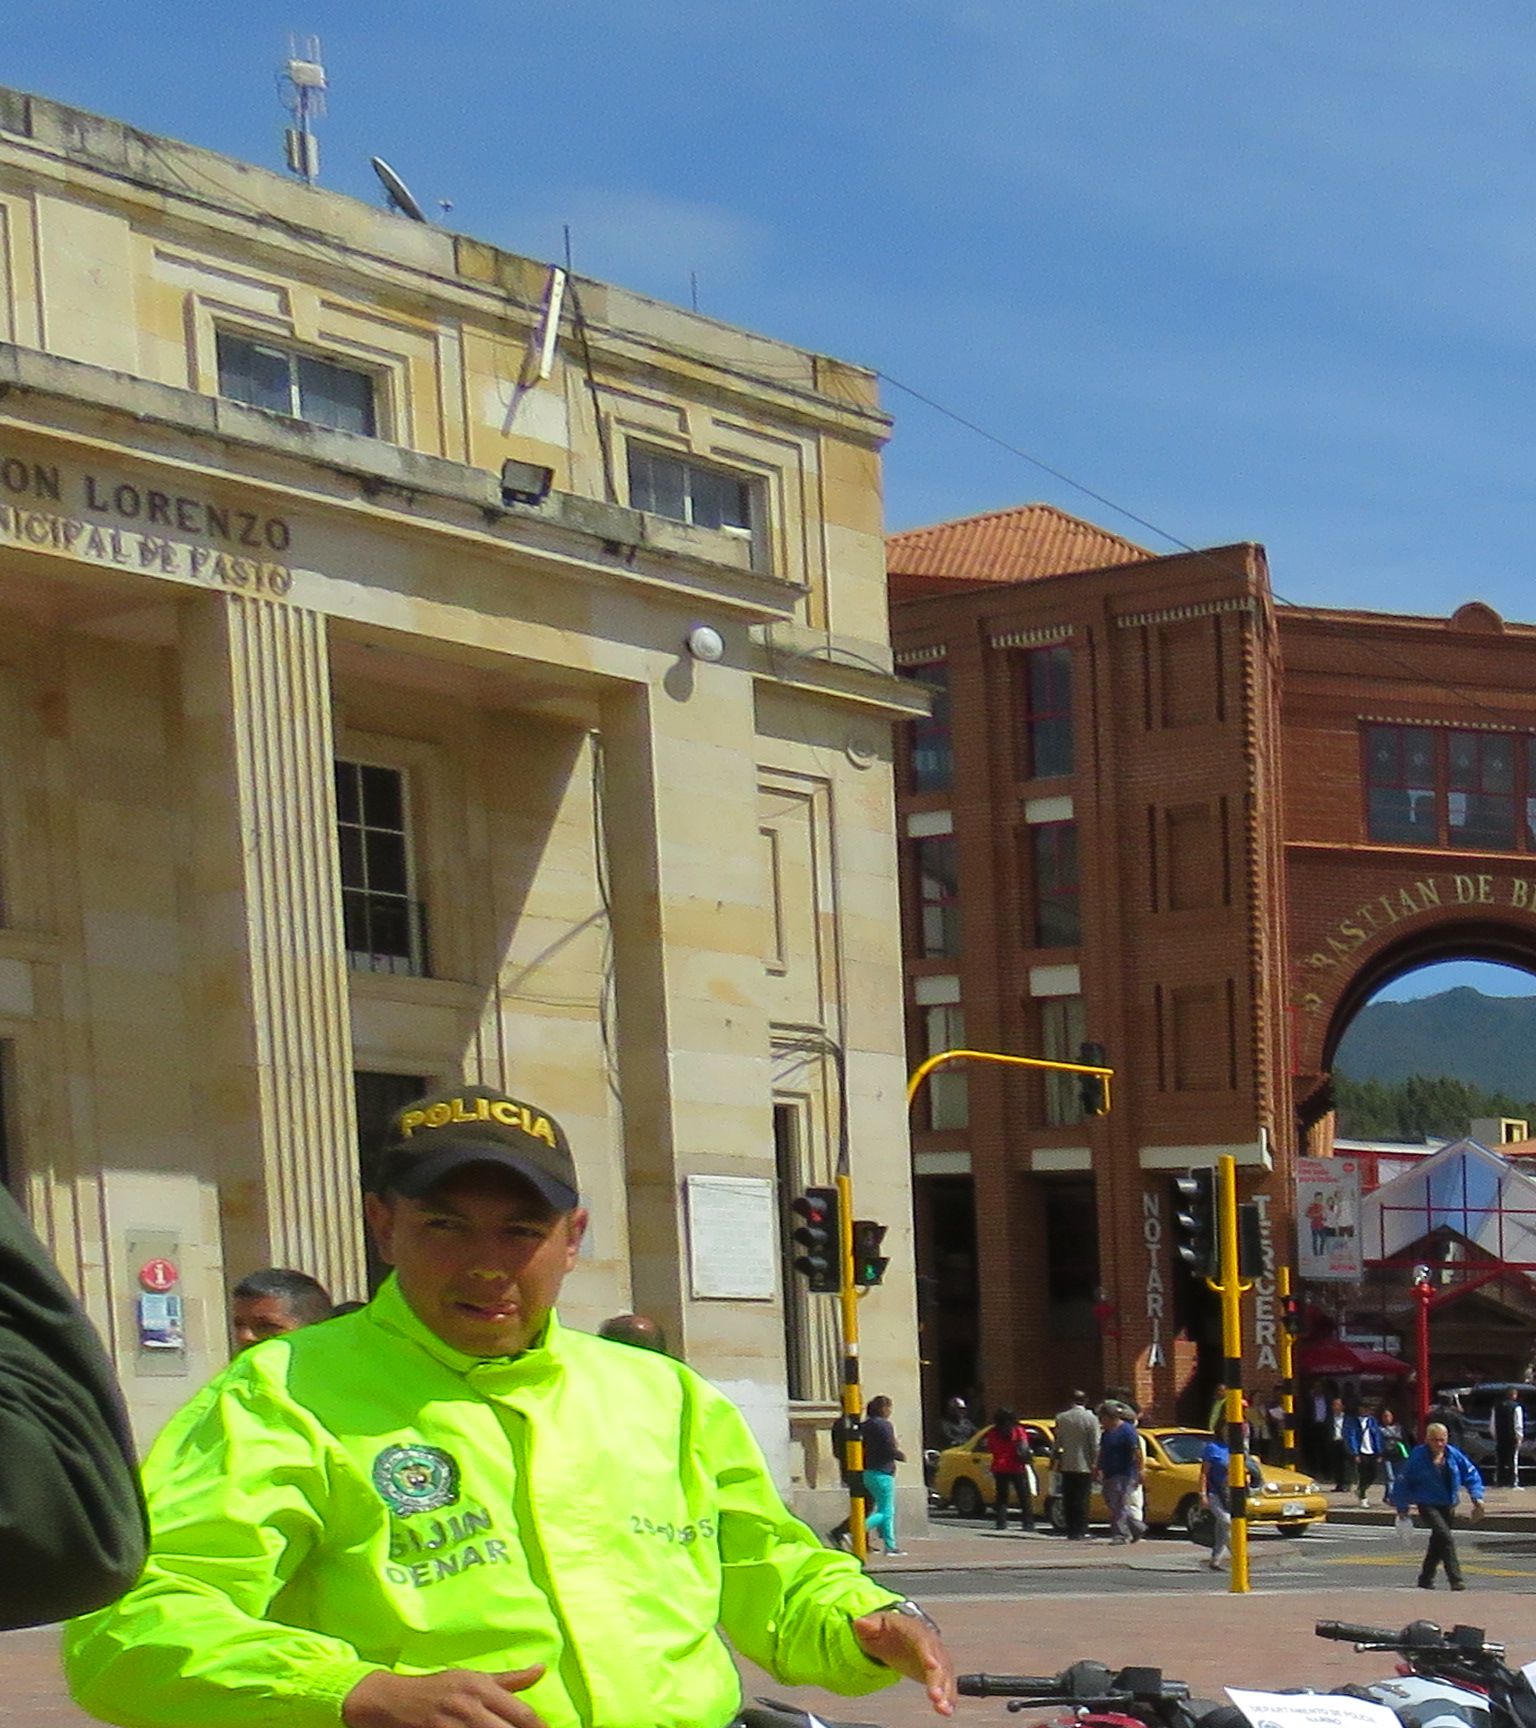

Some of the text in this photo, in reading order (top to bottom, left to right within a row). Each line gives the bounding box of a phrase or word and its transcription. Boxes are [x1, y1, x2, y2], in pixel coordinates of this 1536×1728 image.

[84, 474, 291, 551] LORENZO
[139, 530, 181, 575] DE
[190, 544, 293, 597] PASTO
[1453, 874, 1497, 905] DE
[401, 1097, 557, 1149] POLICIA
[1143, 1191, 1167, 1368] NOTARIA
[1252, 1195, 1278, 1370] TRCERA
[389, 1507, 493, 1558] SIJIN
[384, 1538, 512, 1589] DENAR
